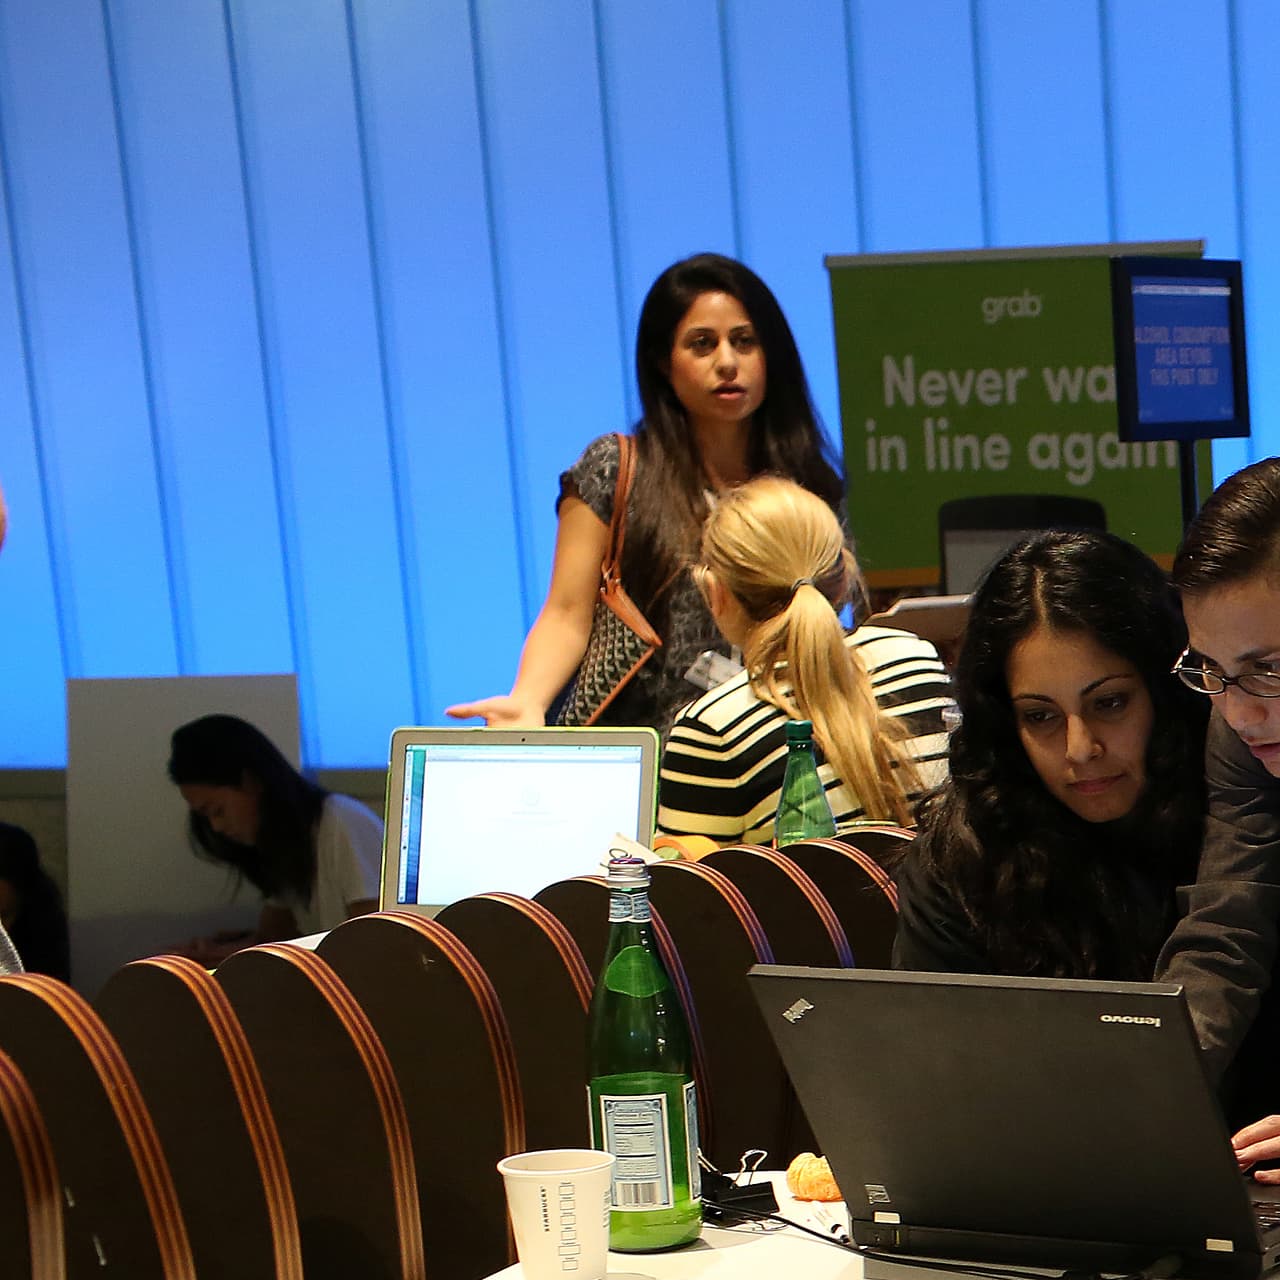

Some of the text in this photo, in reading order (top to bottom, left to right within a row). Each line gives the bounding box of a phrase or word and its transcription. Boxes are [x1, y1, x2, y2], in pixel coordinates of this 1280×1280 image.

[982, 288, 1042, 324] grab
[883, 354, 1117, 407] Never wa
[865, 417, 1178, 486] in line again
[1100, 1014, 1161, 1028] lenovo
[540, 1187, 550, 1232] STARBUCKS
